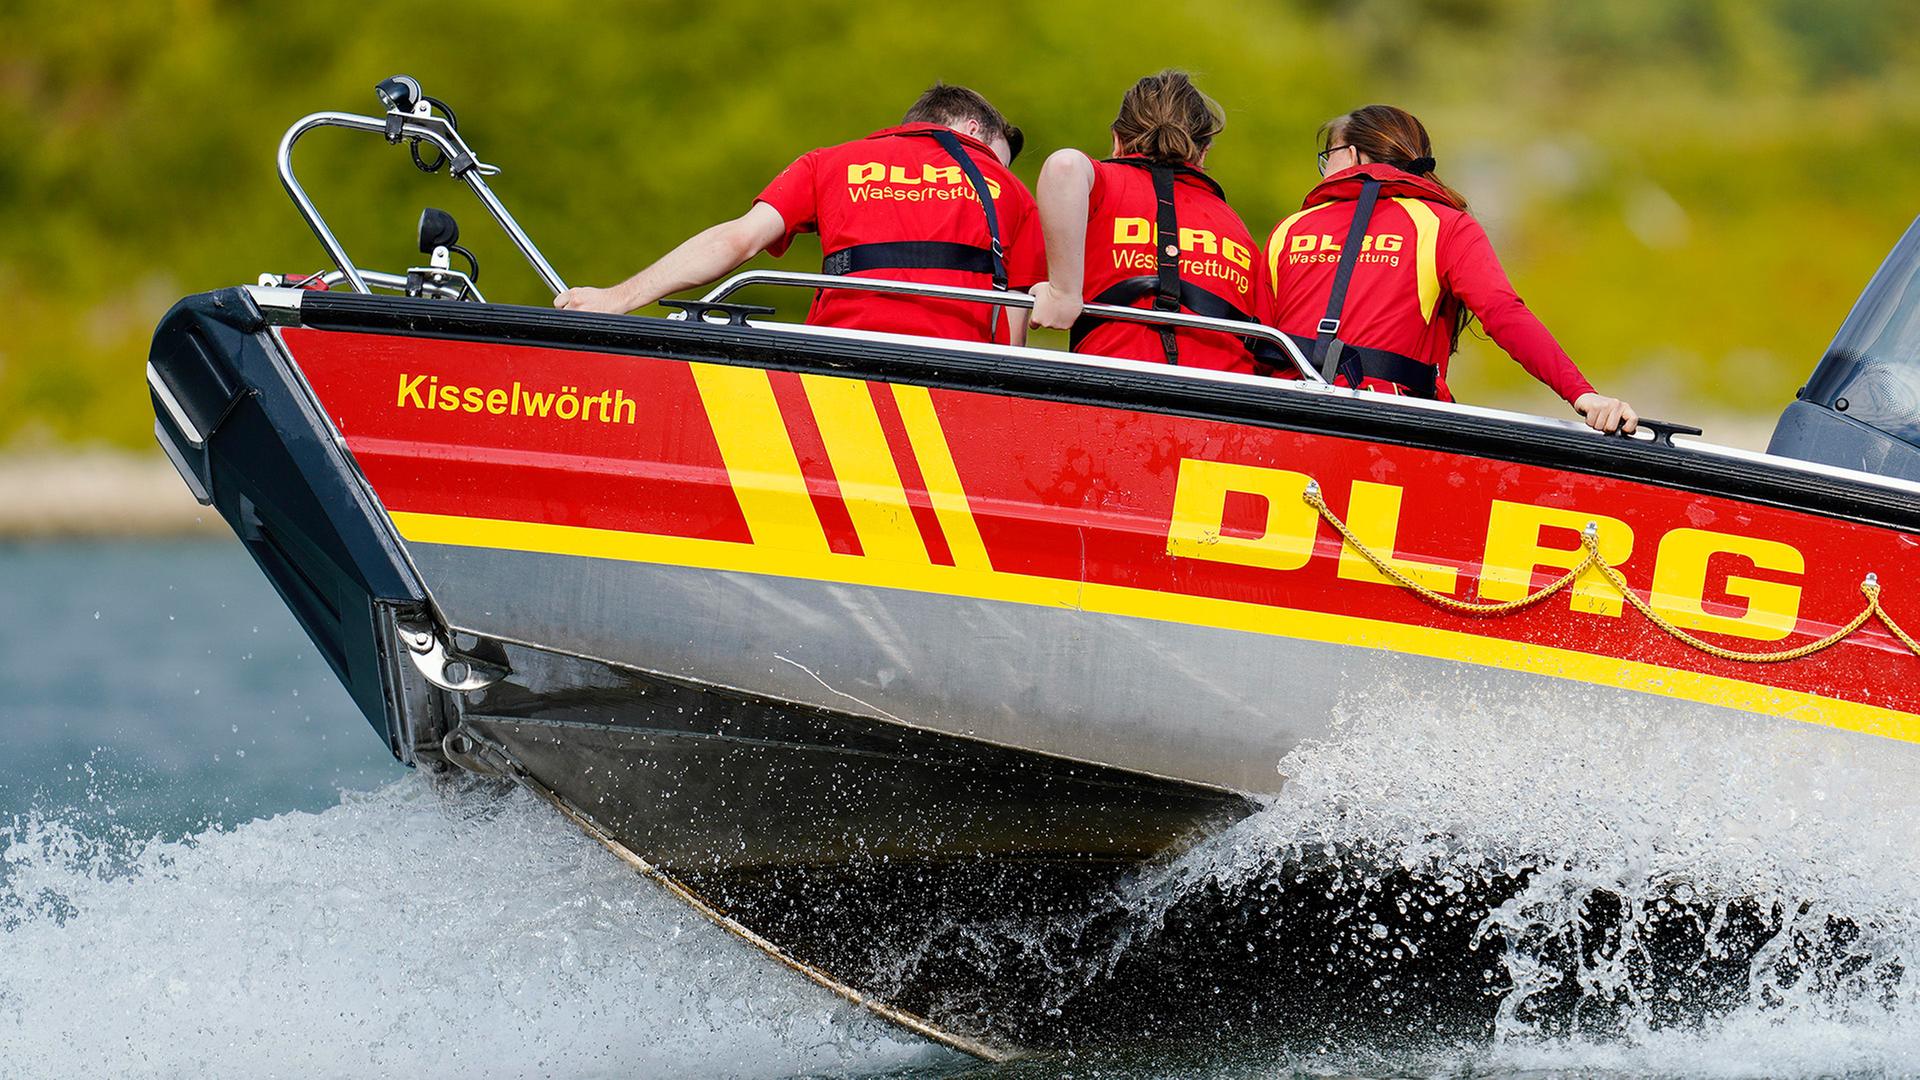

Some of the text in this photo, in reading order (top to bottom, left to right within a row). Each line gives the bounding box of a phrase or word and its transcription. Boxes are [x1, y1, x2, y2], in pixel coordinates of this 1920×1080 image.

[848, 184, 987, 211] Wasserrettun
[1113, 217, 1251, 271] DRG
[1288, 252, 1400, 267] Wasserttung
[1112, 249, 1249, 294] Wasrettung
[396, 373, 637, 425] Kisselwörth
[1166, 457, 1806, 642] DLRG
